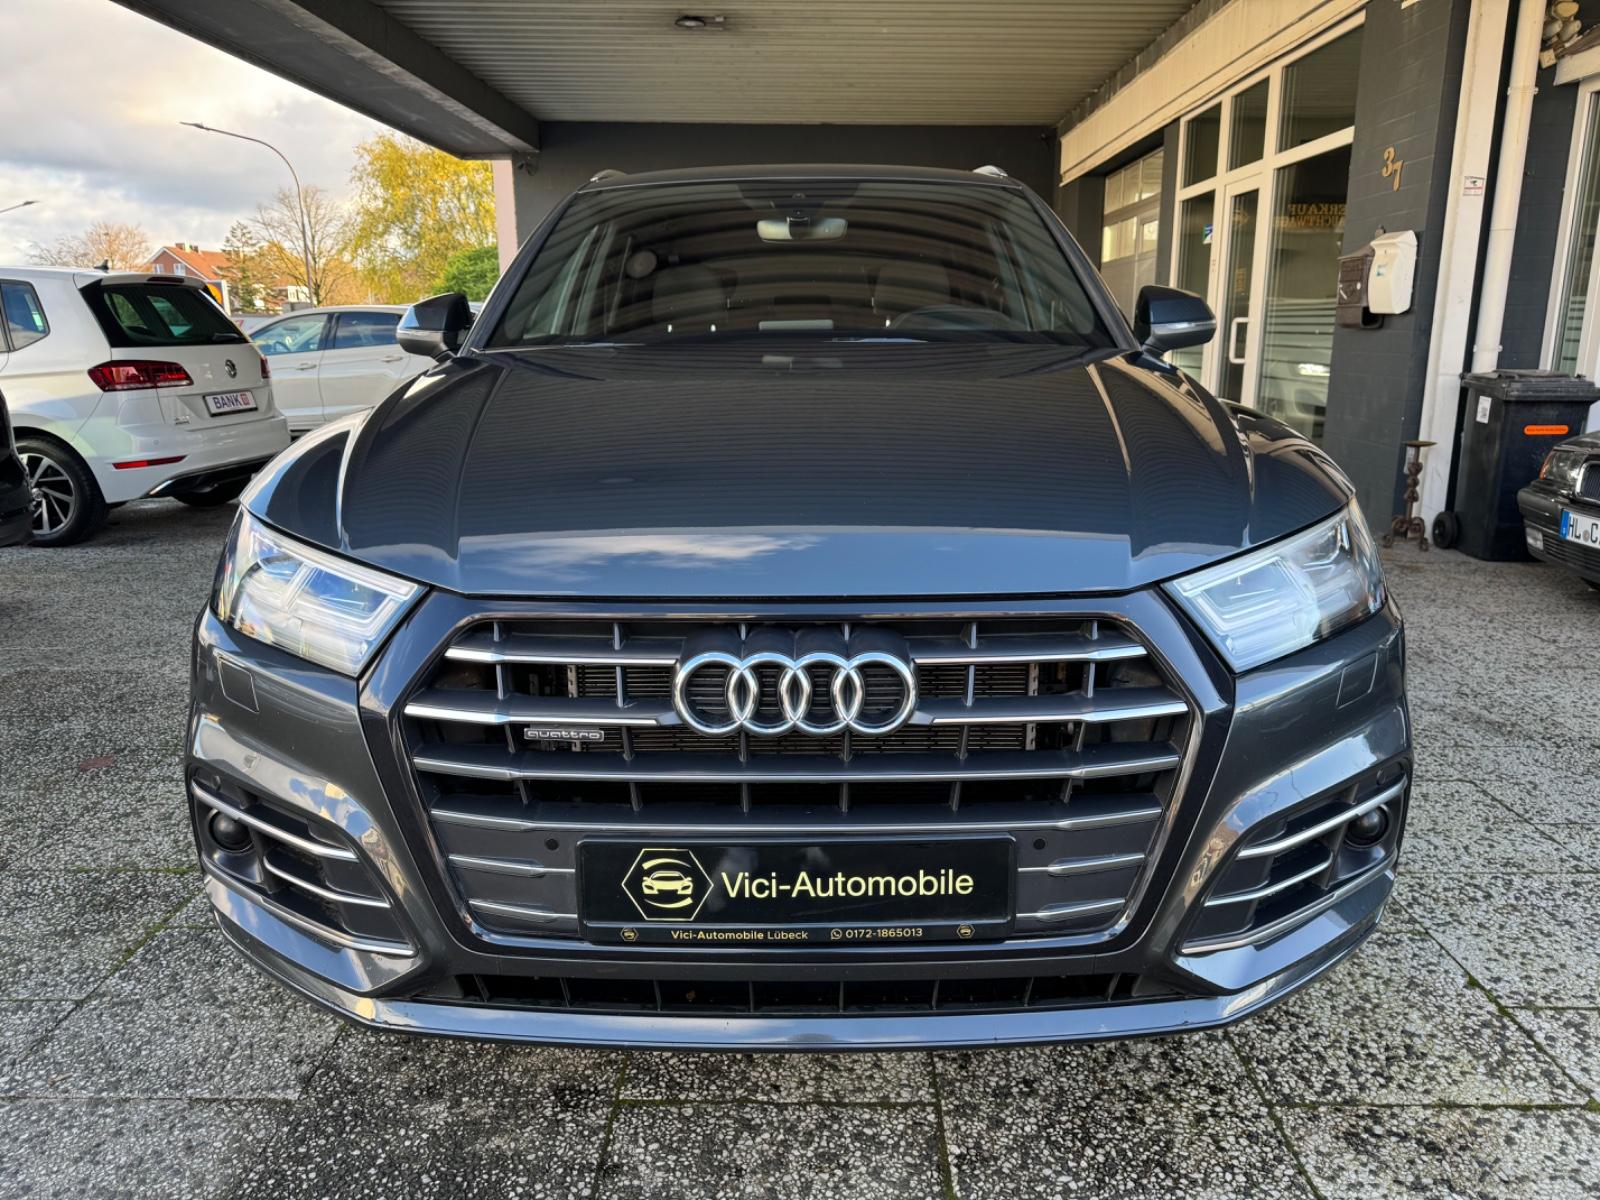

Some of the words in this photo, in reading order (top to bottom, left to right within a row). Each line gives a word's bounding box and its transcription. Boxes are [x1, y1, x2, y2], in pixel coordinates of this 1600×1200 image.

[1382, 146, 1404, 192] 37
[212, 394, 242, 409] BANK
[1569, 515, 1581, 540] HL
[1590, 522, 1600, 545] C
[527, 730, 600, 739] quattro
[721, 869, 974, 898] Vici-Automobile
[671, 930, 764, 940] Vici-Automobile
[767, 930, 809, 940] Lübeck
[845, 928, 923, 939] 0172-1865013
